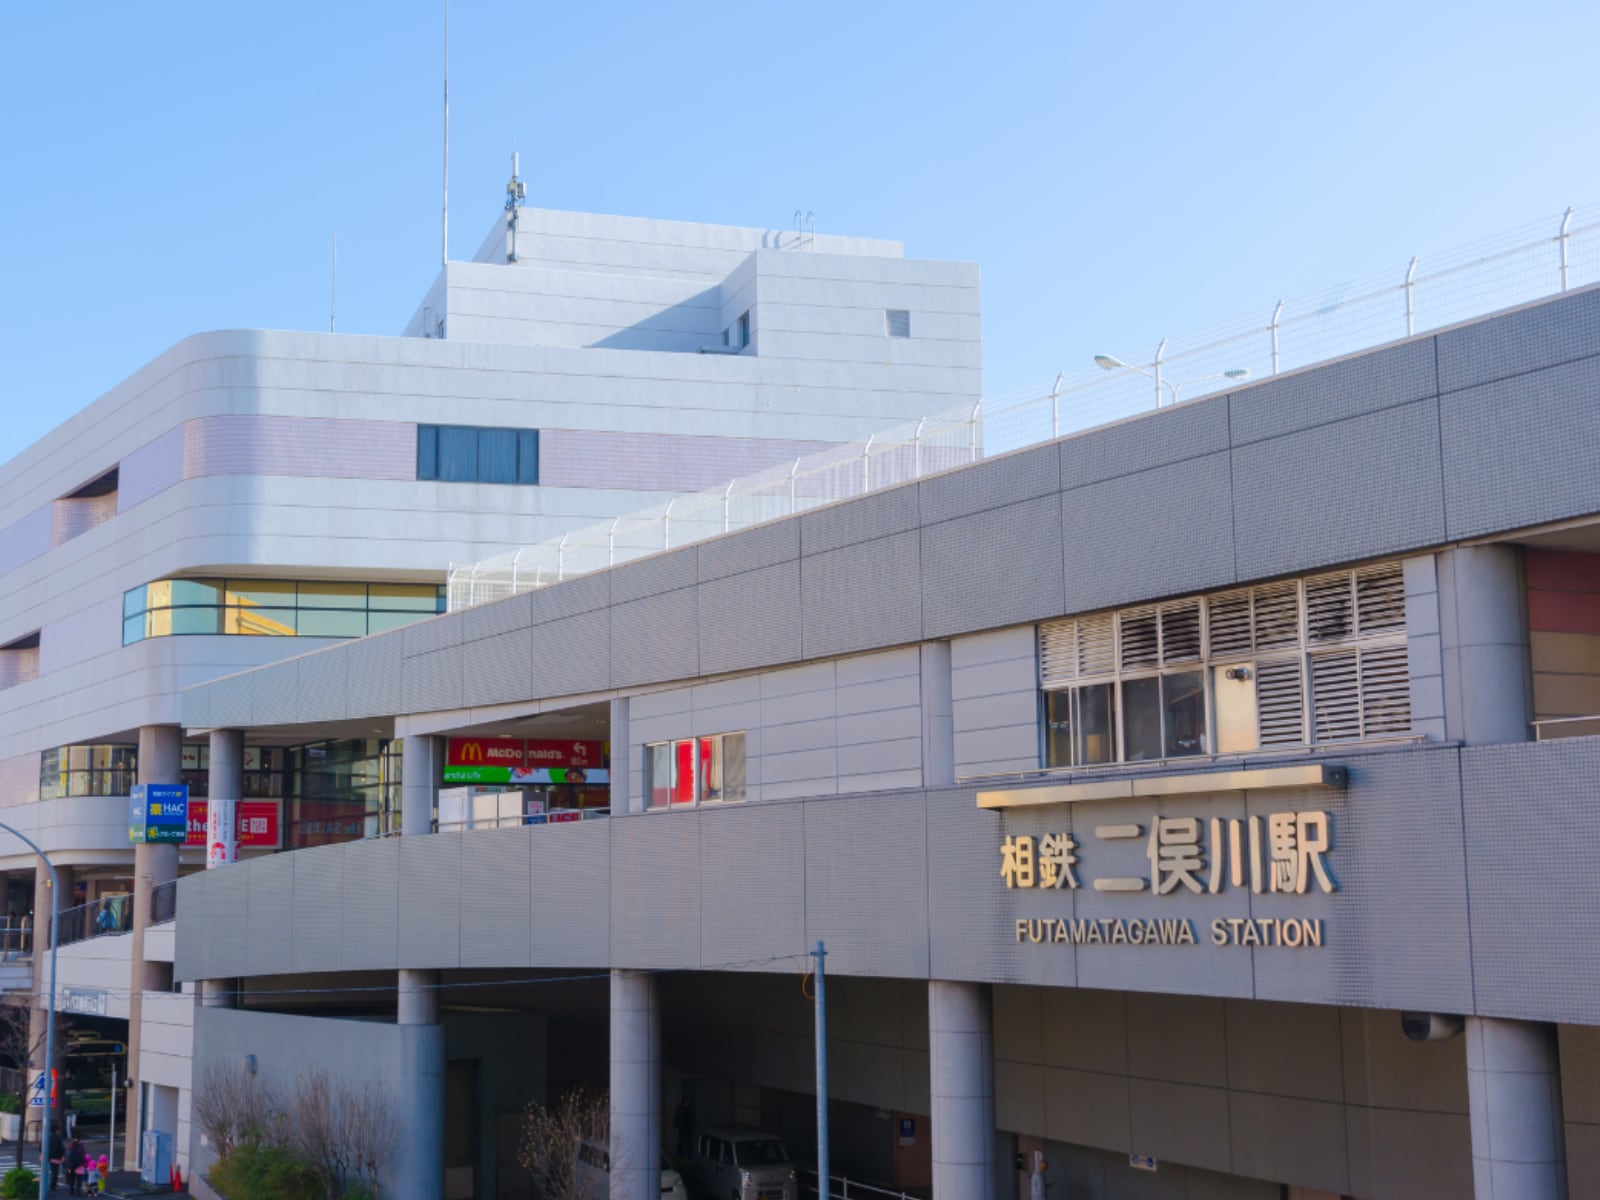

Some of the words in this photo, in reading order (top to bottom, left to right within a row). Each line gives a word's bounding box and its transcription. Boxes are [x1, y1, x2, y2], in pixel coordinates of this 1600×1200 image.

[488, 748, 562, 759] McDonald's
[163, 803, 185, 813] HAC
[188, 818, 208, 832] the
[1000, 833, 1079, 889] 相鉄
[1093, 811, 1334, 894] 二俣川駅
[1016, 918, 1196, 945] FUTAMATAGAWA
[1211, 918, 1322, 947] STATION
